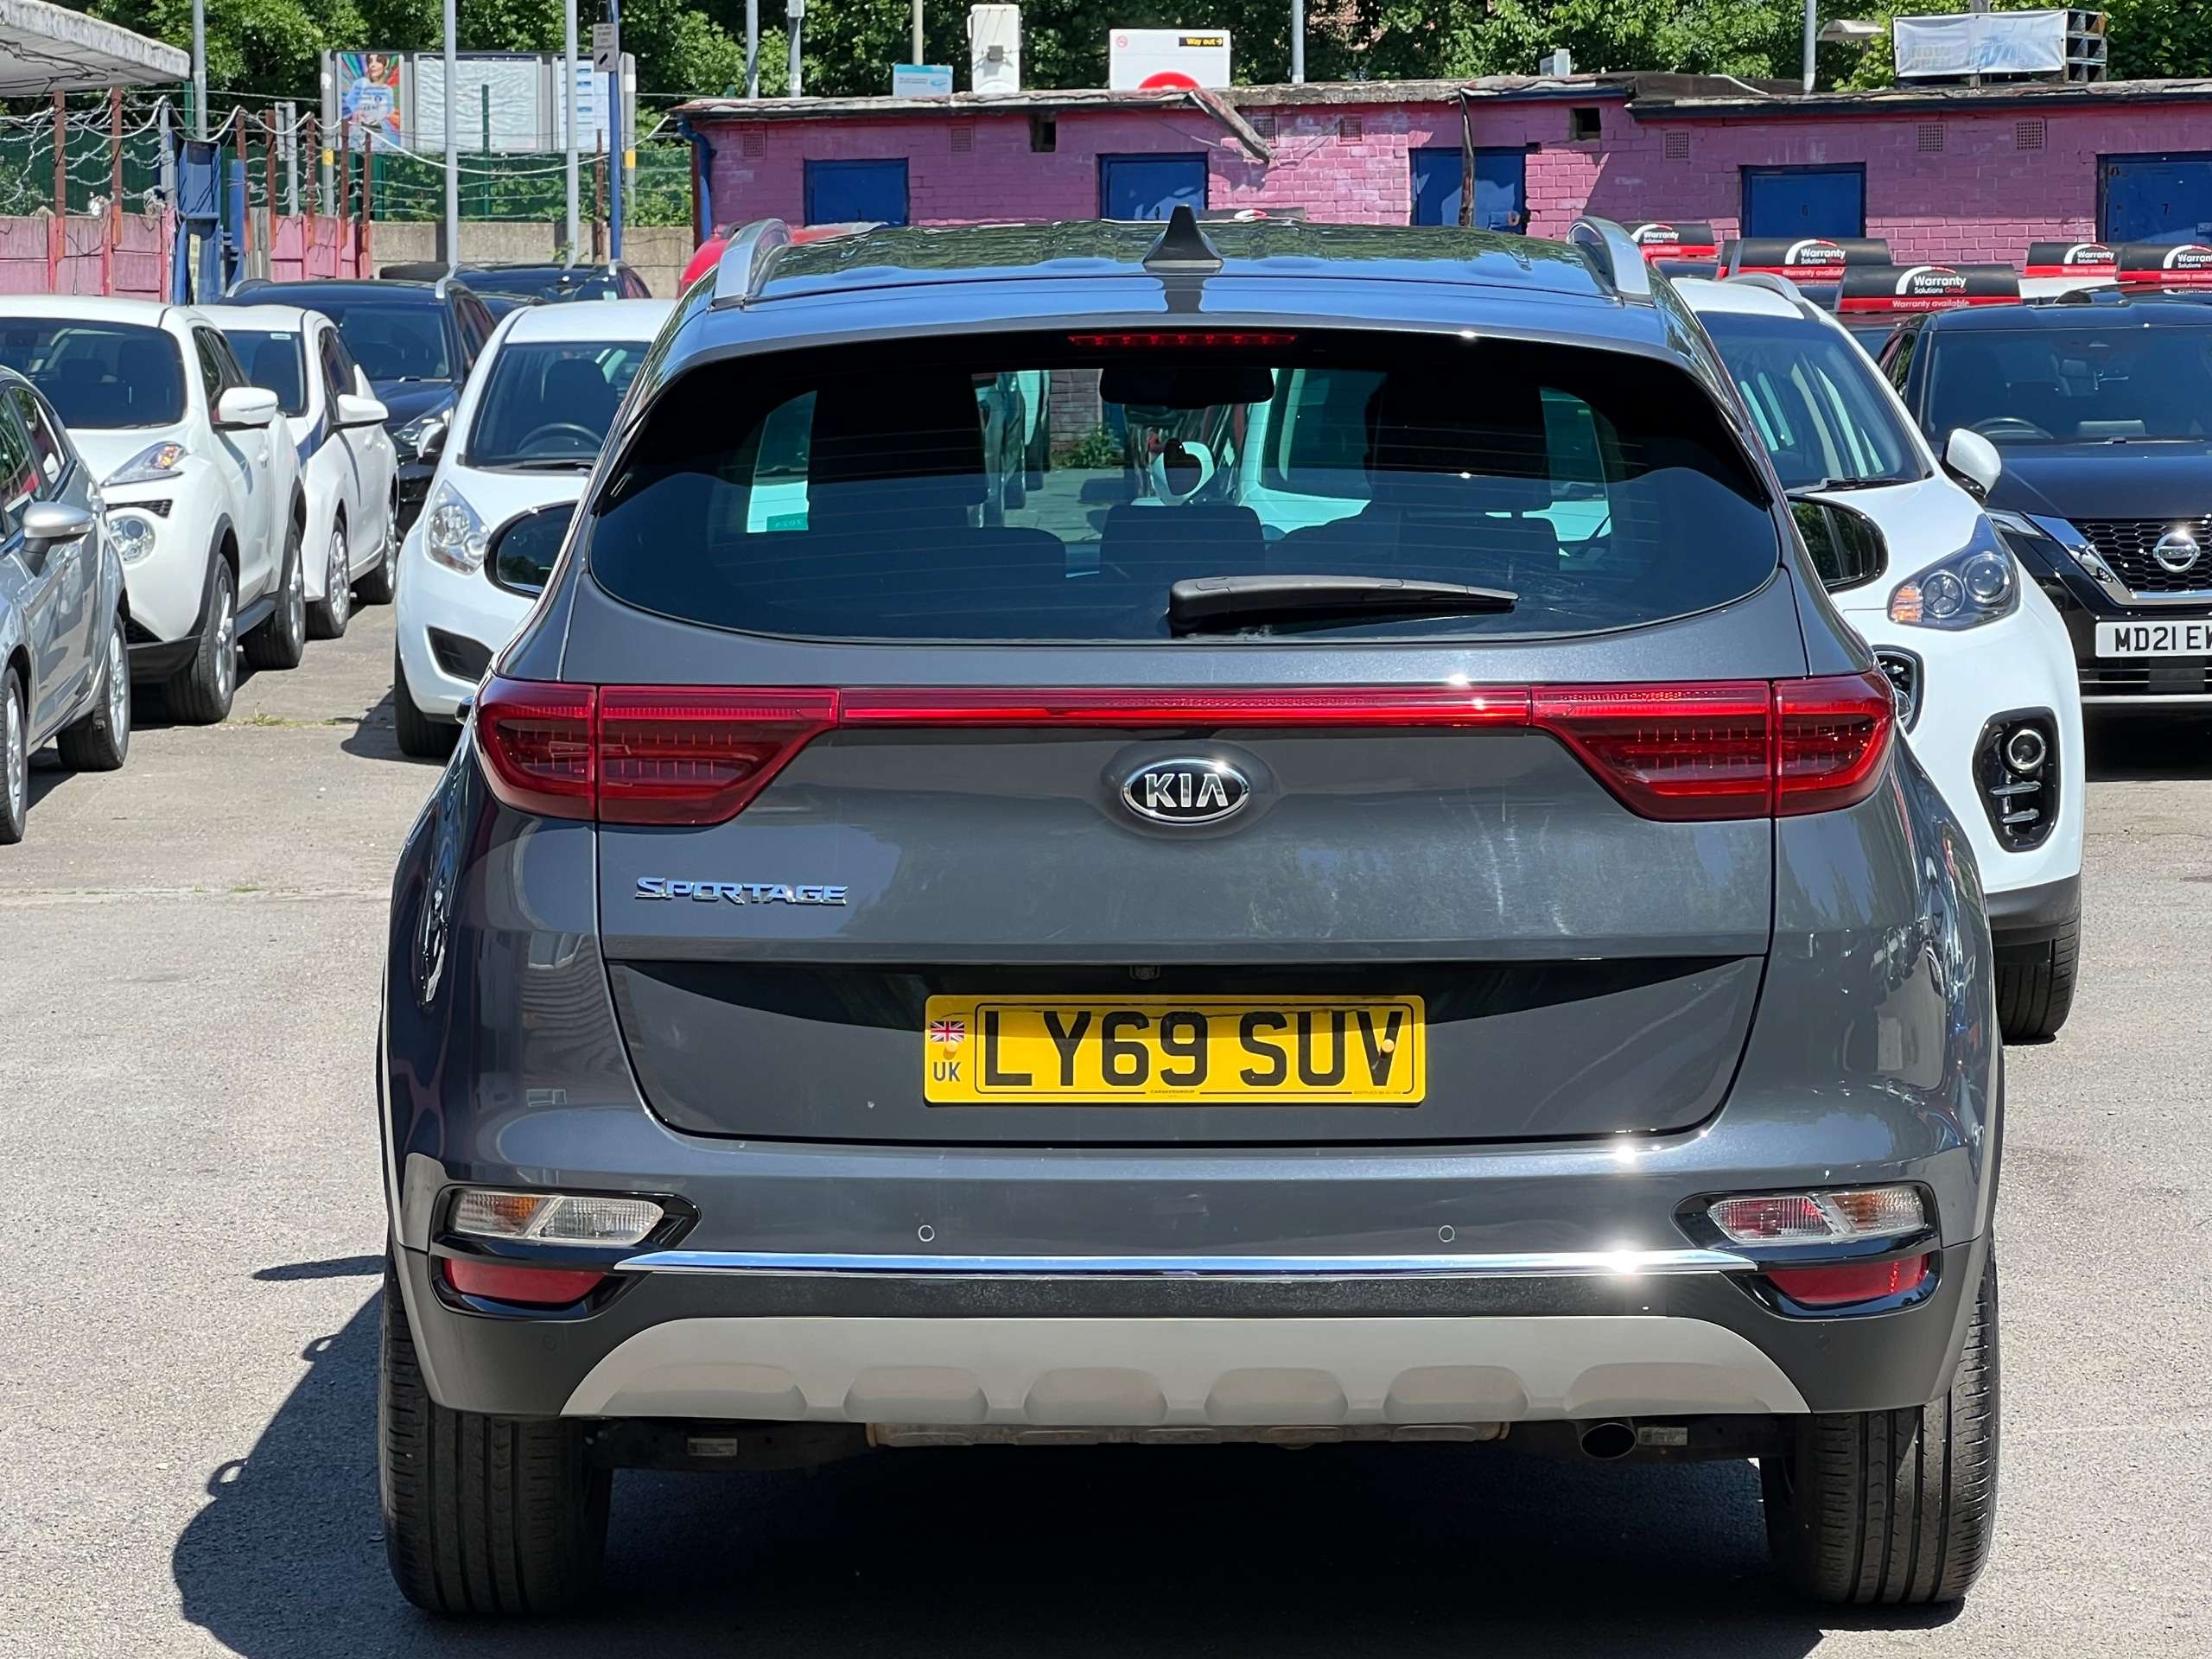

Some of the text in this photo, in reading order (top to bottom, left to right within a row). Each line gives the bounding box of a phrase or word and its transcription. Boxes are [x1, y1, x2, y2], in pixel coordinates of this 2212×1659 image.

[1643, 231, 1679, 240] Warranty
[1801, 249, 1846, 259] Warranty
[2076, 251, 2114, 260] Warranty
[1914, 276, 1967, 288] Warranty
[1892, 299, 1970, 309] Warranty available
[2115, 626, 2176, 652] MD21
[1145, 773, 1229, 807] KIA
[635, 877, 849, 905] SPORTAGE
[985, 1011, 1403, 1086] LY69 SUV
[933, 1062, 961, 1082] UK
